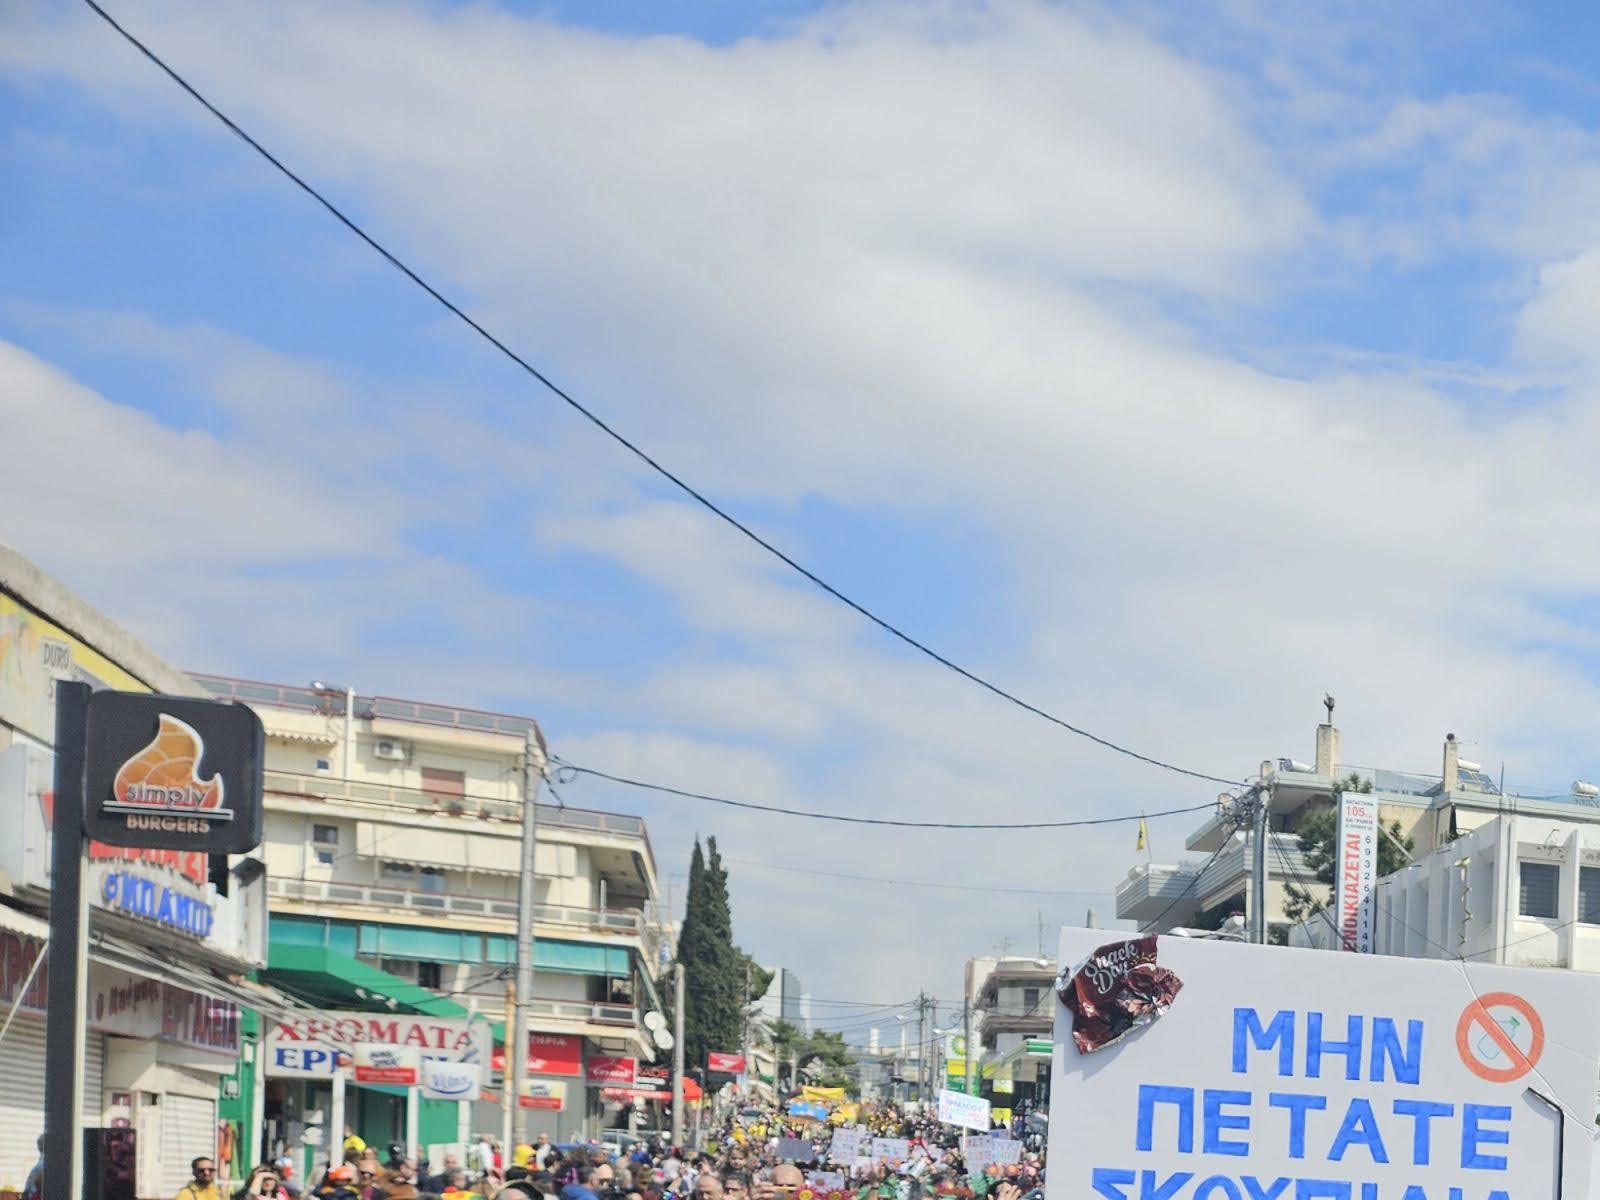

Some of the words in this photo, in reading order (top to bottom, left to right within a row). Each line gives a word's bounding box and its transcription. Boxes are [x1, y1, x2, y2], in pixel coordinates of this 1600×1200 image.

[127, 783, 207, 809] simply
[126, 814, 211, 834] BURGERS
[1084, 941, 1138, 977] Snack
[1231, 1006, 1424, 1085] ΜΗΝ
[1135, 1083, 1513, 1171] ΠΕΤΑΤΕ
